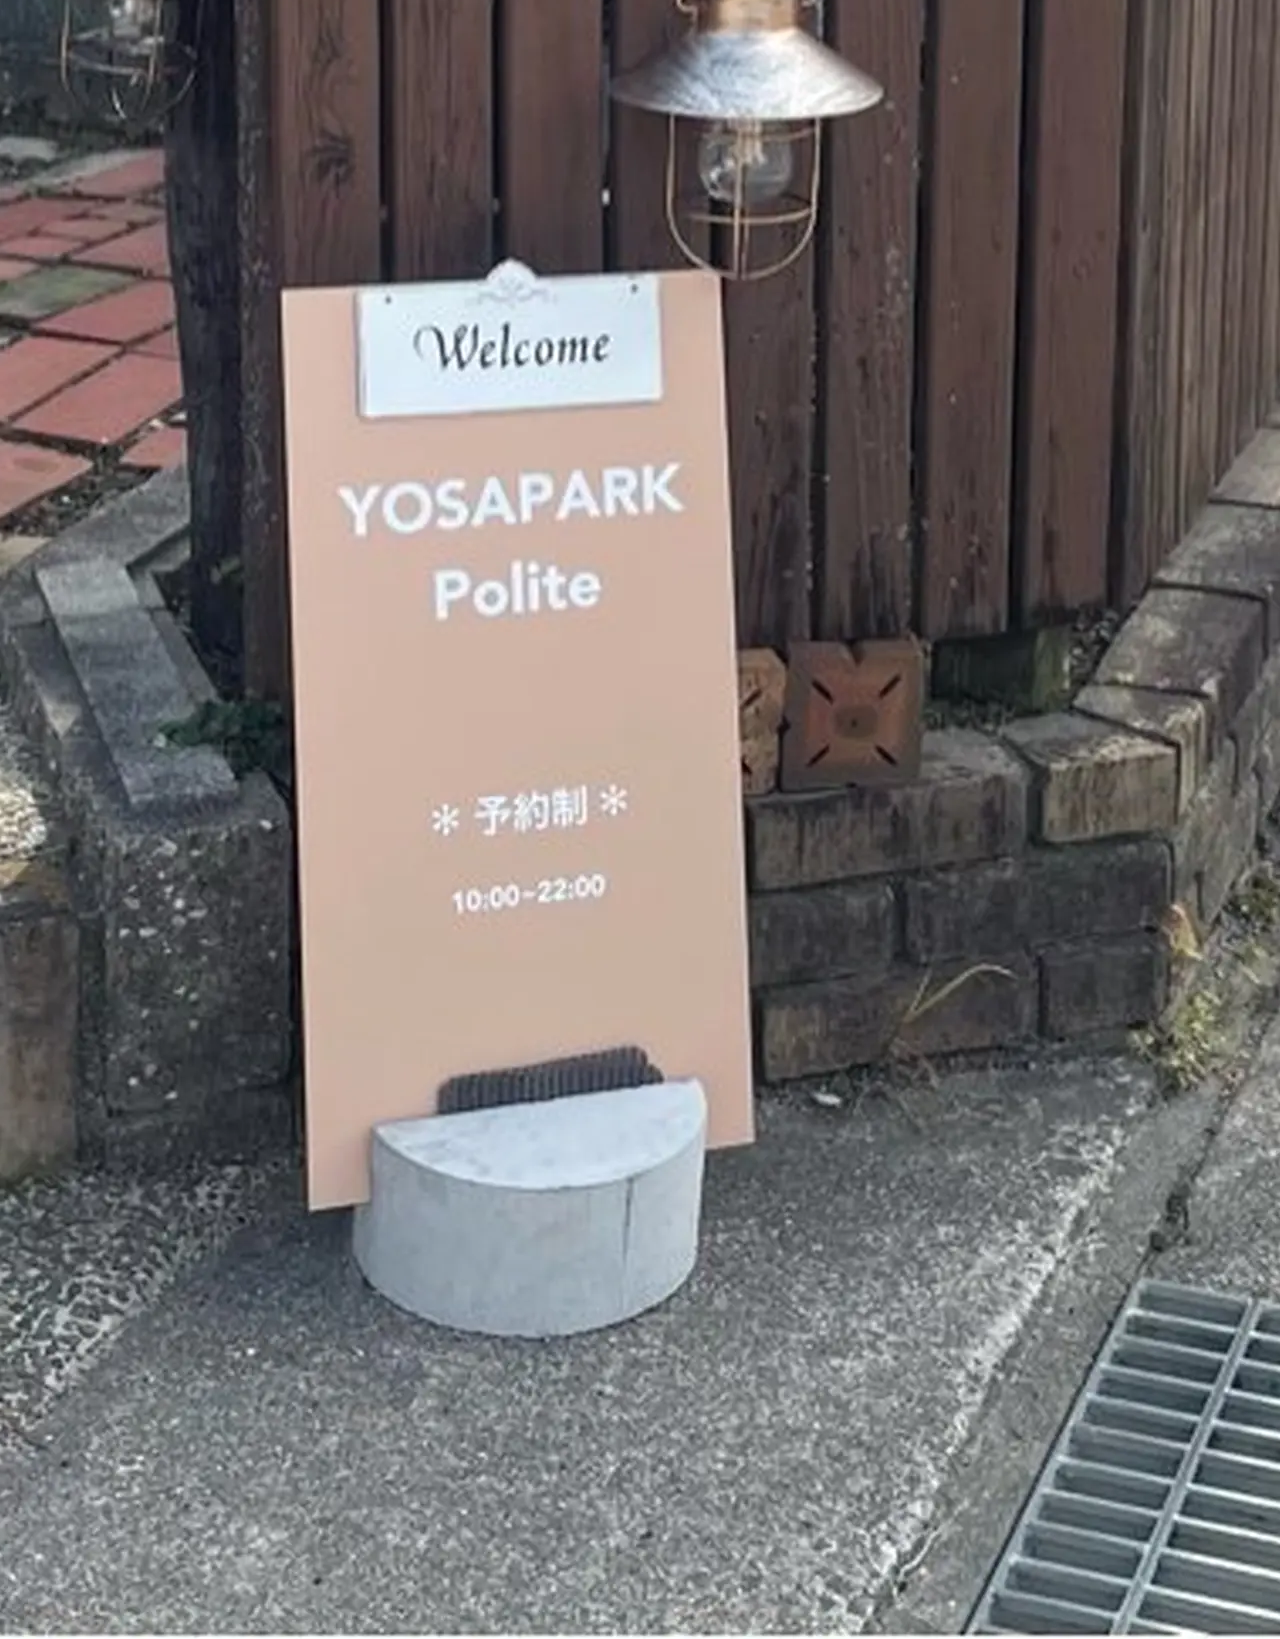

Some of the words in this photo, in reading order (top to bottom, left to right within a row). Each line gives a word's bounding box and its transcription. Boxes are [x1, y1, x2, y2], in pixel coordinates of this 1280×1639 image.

[413, 322, 611, 371] Welcome
[337, 462, 685, 537] YOSAPARK
[433, 562, 602, 621] Polite
[474, 784, 588, 837] 予約制
